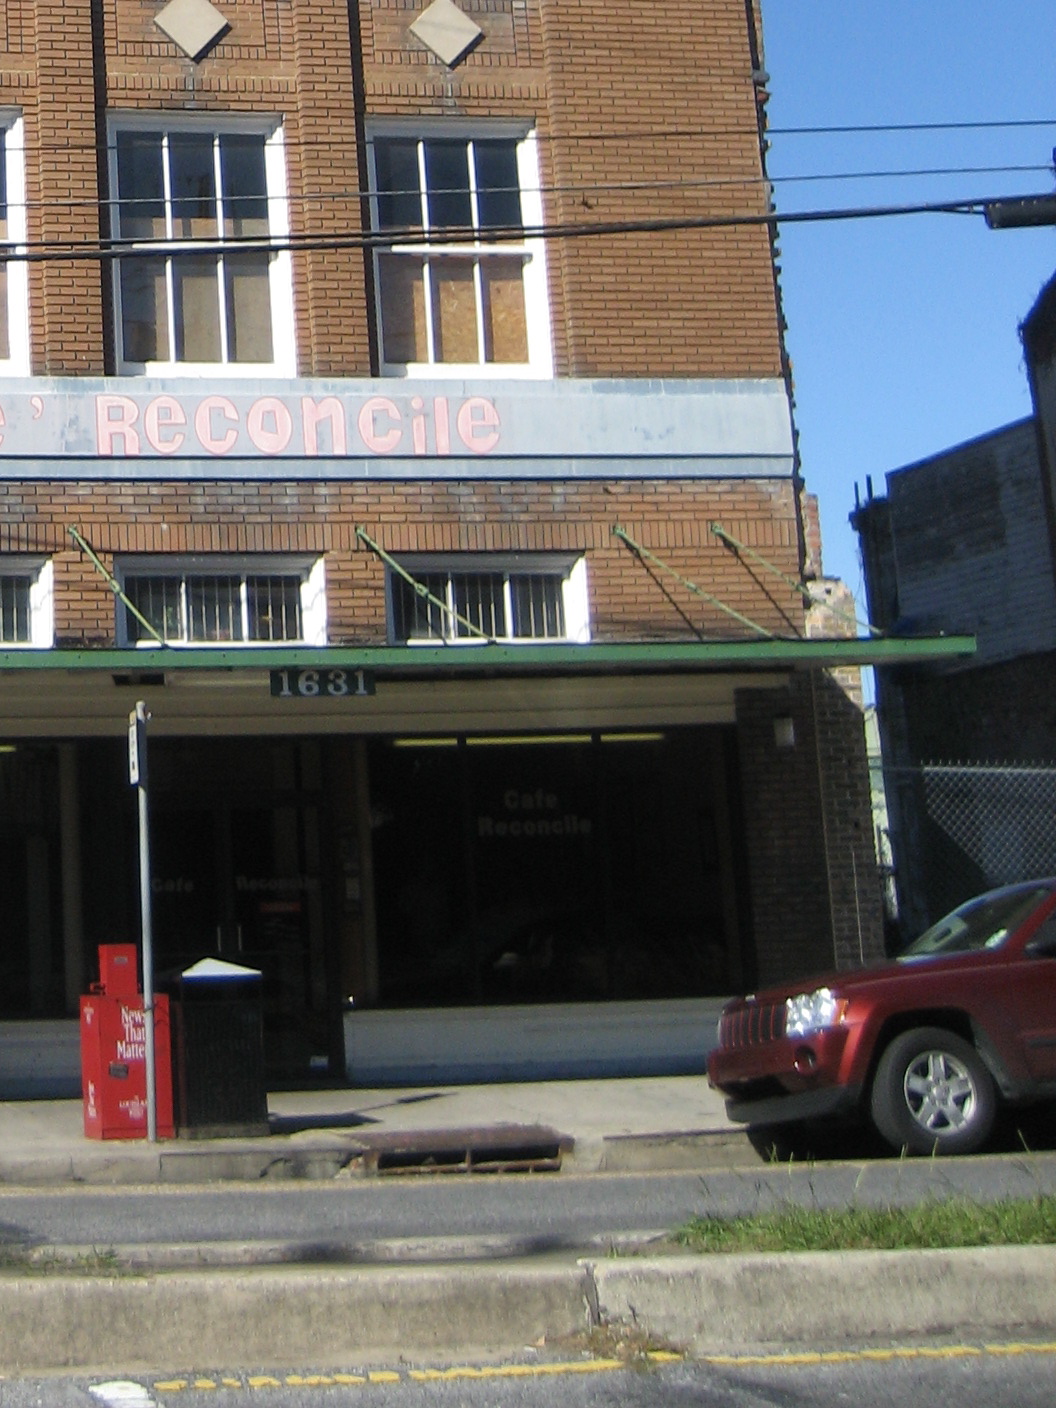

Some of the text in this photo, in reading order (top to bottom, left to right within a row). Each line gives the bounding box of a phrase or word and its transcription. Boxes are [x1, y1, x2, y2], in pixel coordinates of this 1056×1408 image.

[95, 395, 501, 455] Reconcile
[279, 670, 367, 697] 1631
[503, 788, 557, 809] Cafe
[477, 815, 592, 836] Reconcile
[116, 1040, 145, 1059] Matte
